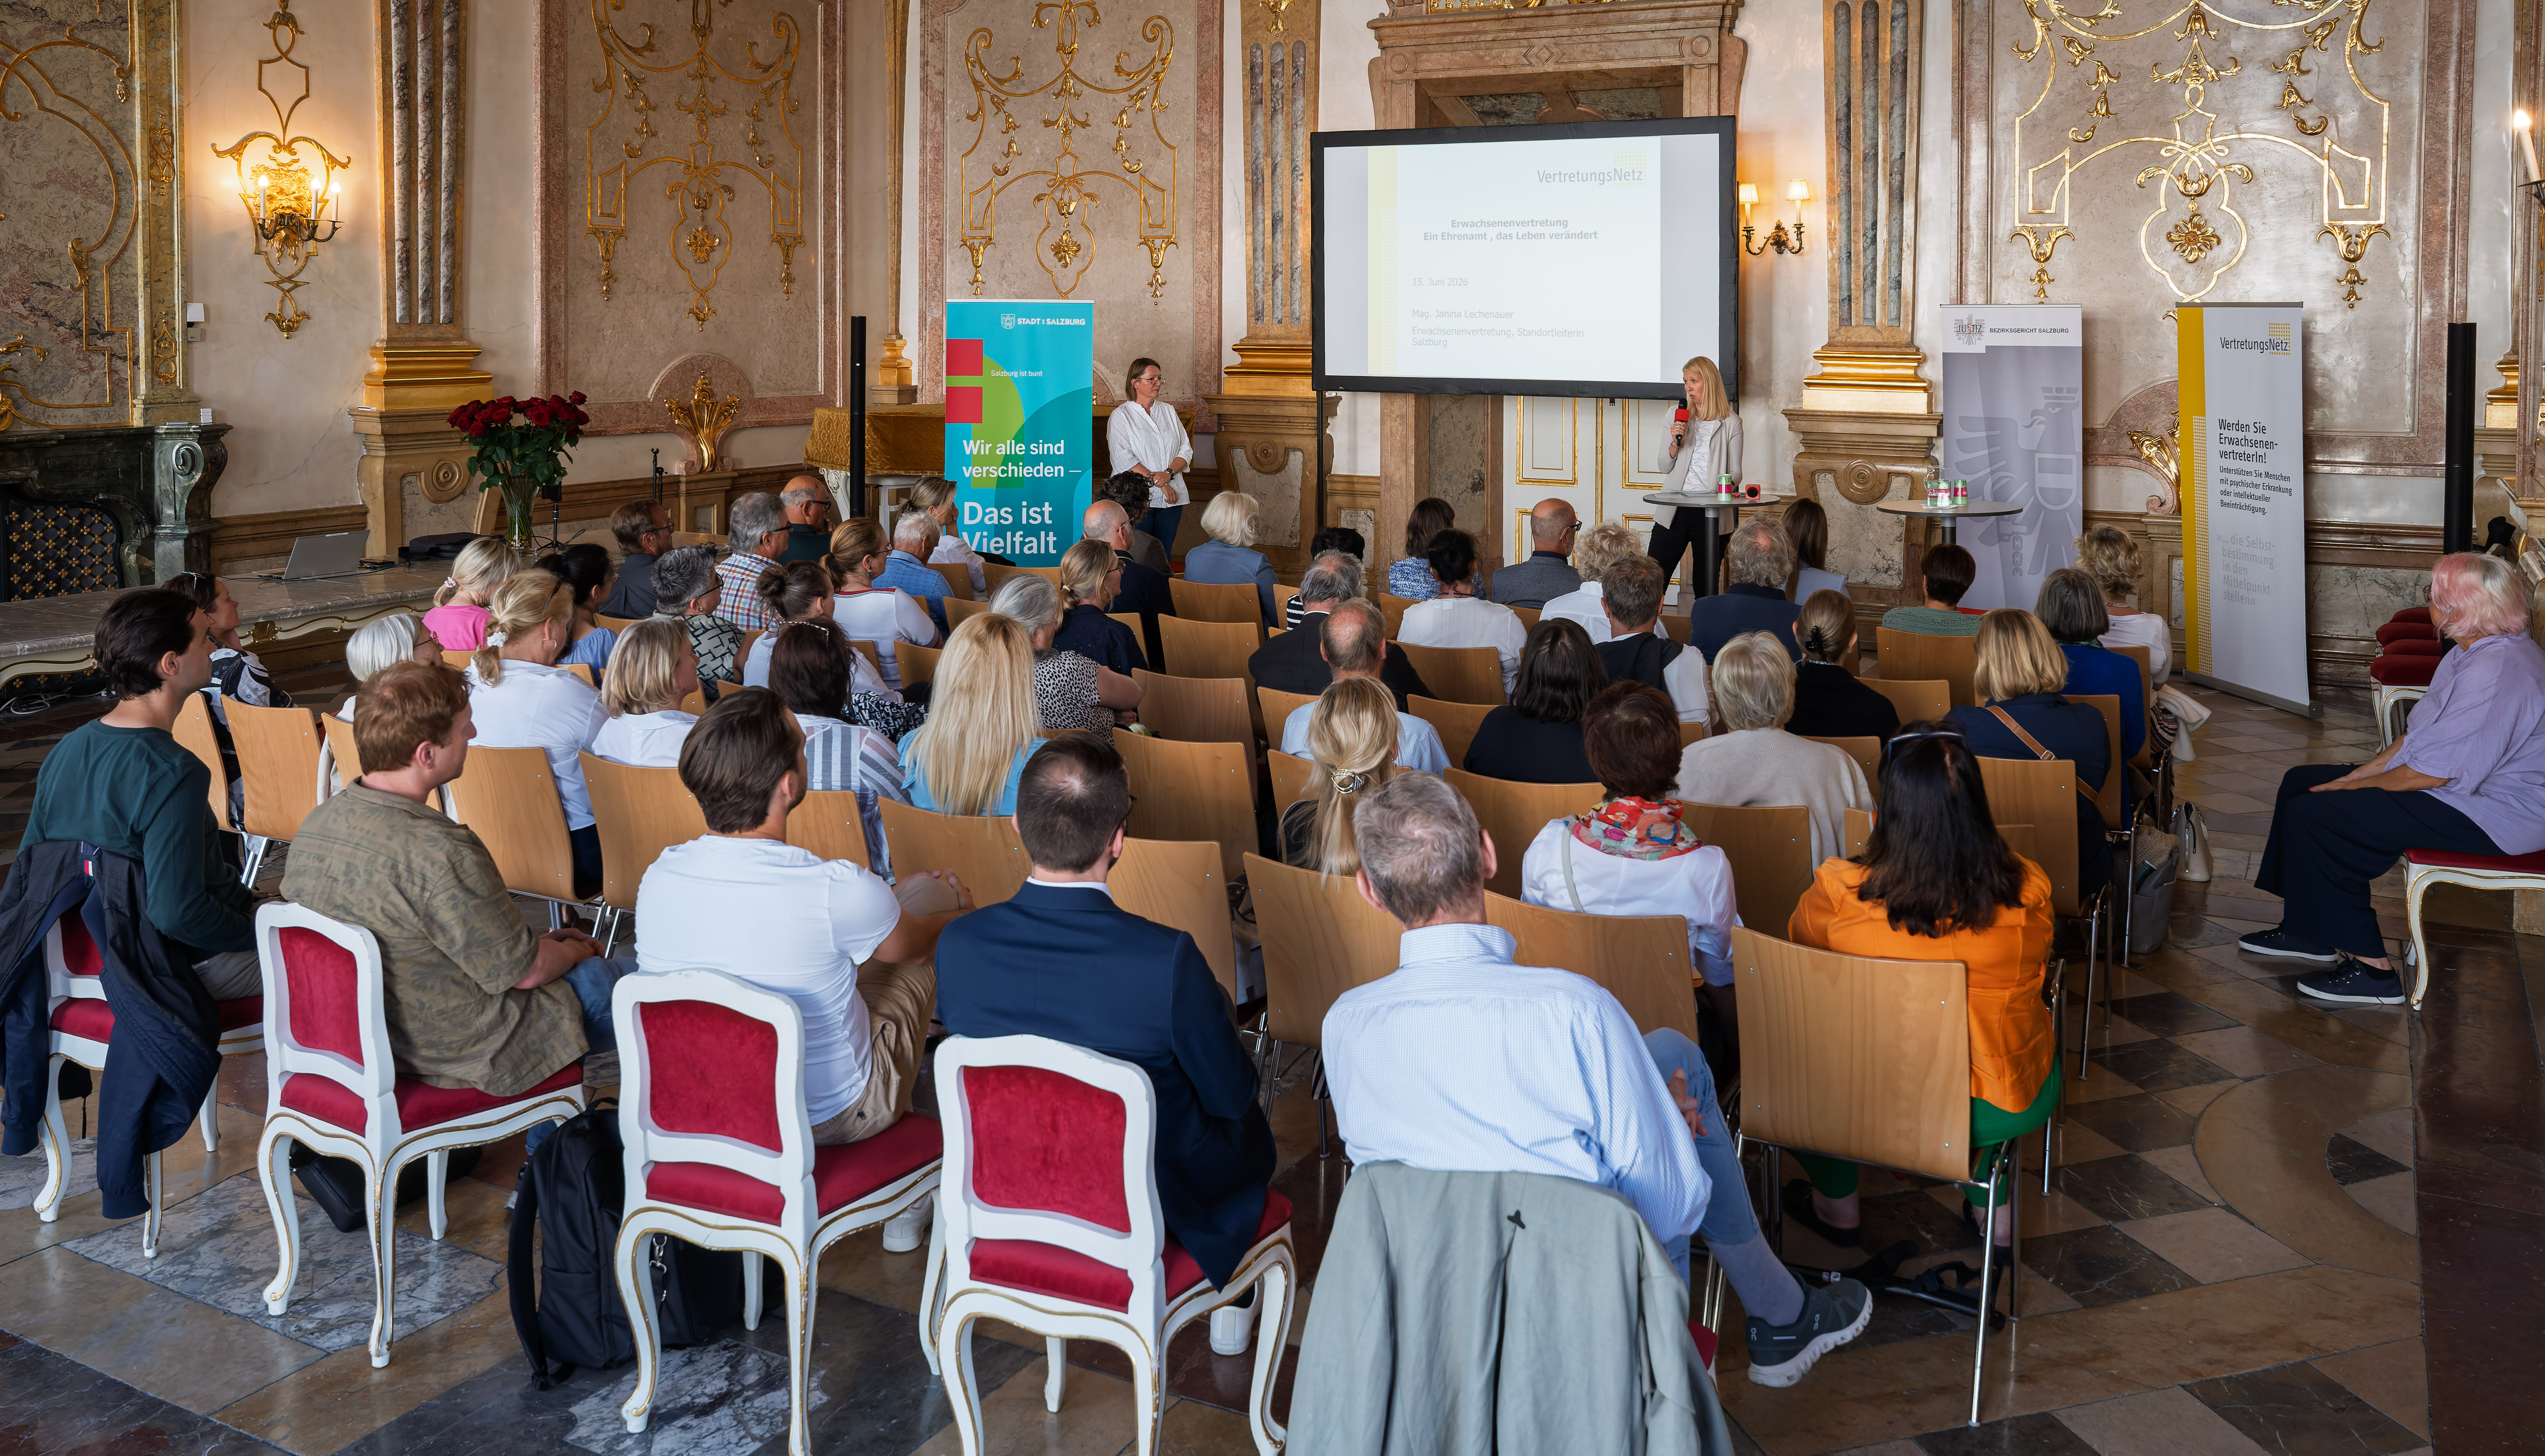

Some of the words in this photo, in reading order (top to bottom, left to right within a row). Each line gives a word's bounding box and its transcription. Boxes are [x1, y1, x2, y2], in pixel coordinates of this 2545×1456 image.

[1537, 168, 1642, 185] VertretungsNetz
[1451, 217, 1568, 229] Erwachsenenvertretung
[1424, 232, 1438, 240] Ein
[1441, 231, 1487, 240] Ehrenamt
[1496, 231, 1513, 240] das
[1516, 231, 1545, 240] Leben
[1548, 230, 1598, 240] verändert
[1412, 277, 1425, 286] 15.
[1428, 277, 1445, 286] Juni
[1447, 277, 1468, 286] 2026
[1412, 310, 1432, 320] Mag.
[1435, 310, 1462, 318] Janina
[1465, 310, 1514, 318] Lechenauer
[1412, 326, 1514, 338] Erwachsenenvertretung,
[1517, 328, 1584, 337] Standortleiterin
[1412, 337, 1448, 348] Salzburg
[2220, 337, 2288, 353] VertretungsNetz
[2219, 419, 2250, 433] Werden
[2253, 422, 2266, 434] Sie
[963, 440, 992, 455] Wir
[996, 439, 1026, 455] alle
[1030, 439, 1064, 455] sind
[2219, 433, 2278, 450] Erwachsenen-
[2219, 449, 2266, 464] vertreterIn!
[963, 462, 1064, 477] verschieden
[2220, 465, 2253, 476] Unterstützen
[2254, 469, 2262, 478] Sie
[2264, 471, 2290, 482] Menschen
[2220, 489, 2232, 497] oder
[2233, 491, 2270, 502] intellektueller
[2230, 479, 2261, 490] psychischer
[2262, 483, 2292, 496] Erkrankung
[964, 502, 1013, 524] Das
[1022, 501, 1052, 524] ist
[2220, 500, 2267, 515] Beeinträchtigung.
[962, 531, 1056, 554] Vielfalt
[2231, 533, 2242, 546] die
[2246, 536, 2275, 552] Selbst-
[2223, 545, 2274, 569] bestimmung
[2223, 560, 2229, 572] in
[2233, 562, 2248, 576] den
[2223, 575, 2271, 595] Mittelpunkt
